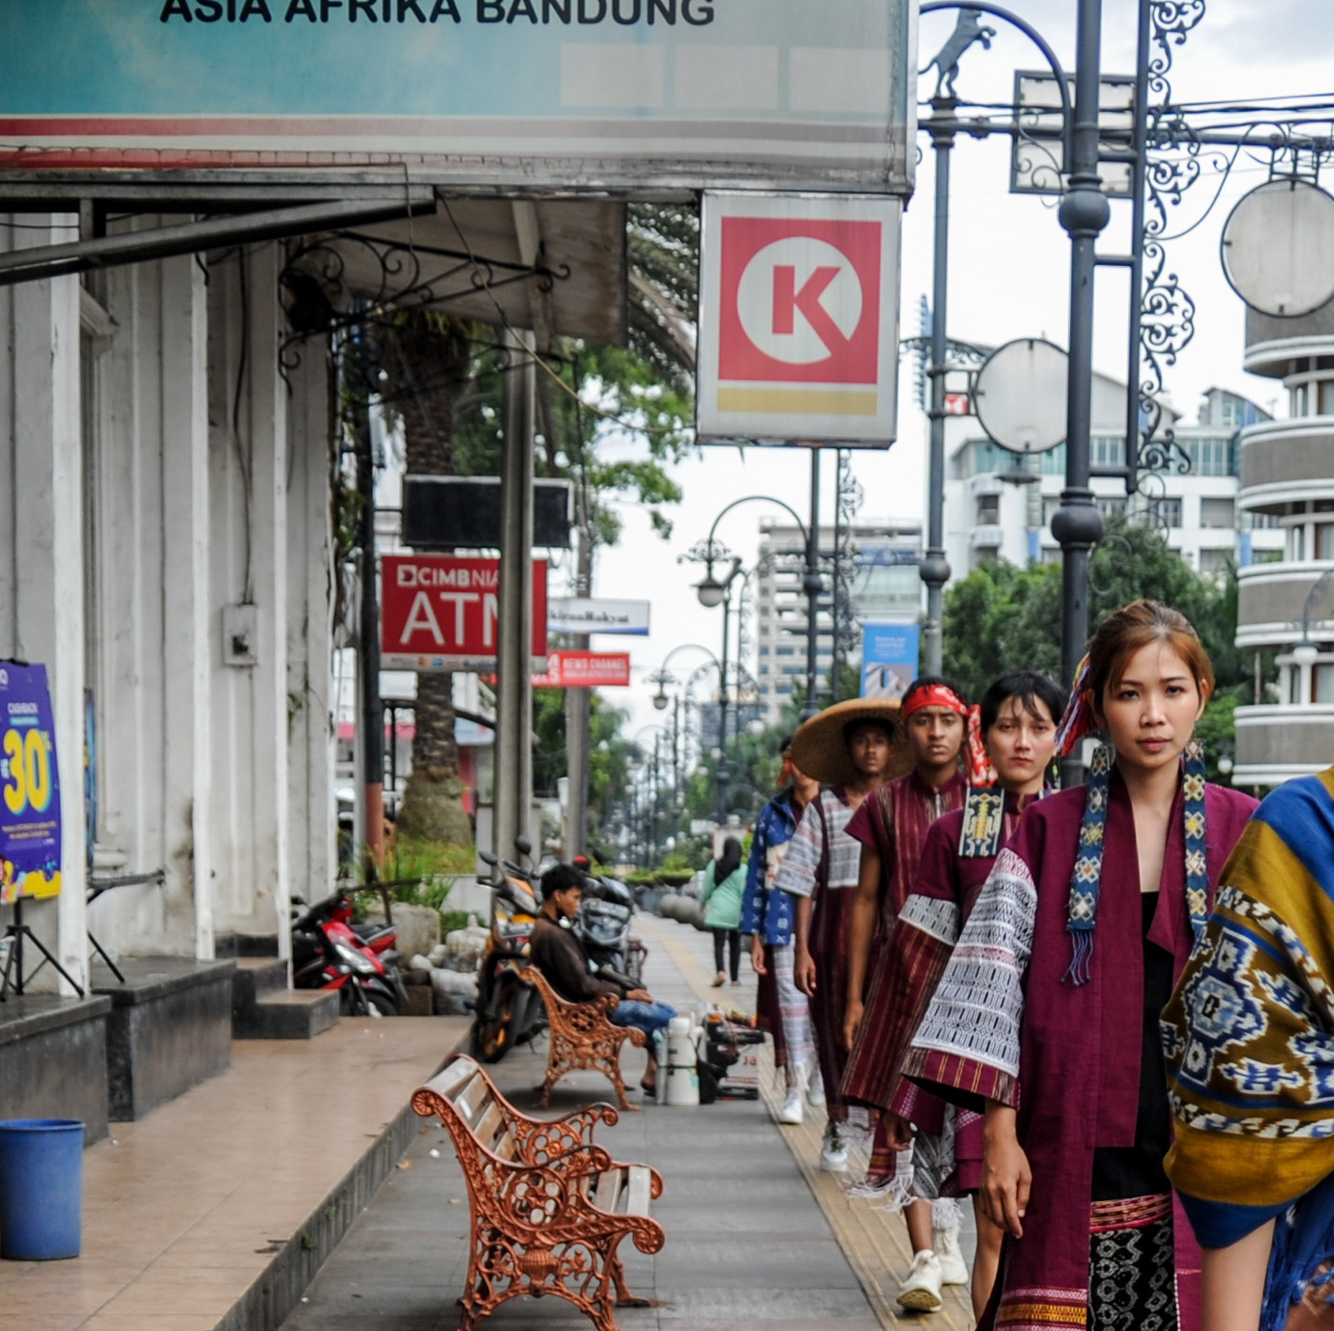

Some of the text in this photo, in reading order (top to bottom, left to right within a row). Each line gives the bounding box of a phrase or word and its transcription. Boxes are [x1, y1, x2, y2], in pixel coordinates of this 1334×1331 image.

[158, 0, 714, 26] ASIA AFRIKA BANDUNG
[773, 265, 847, 352] K
